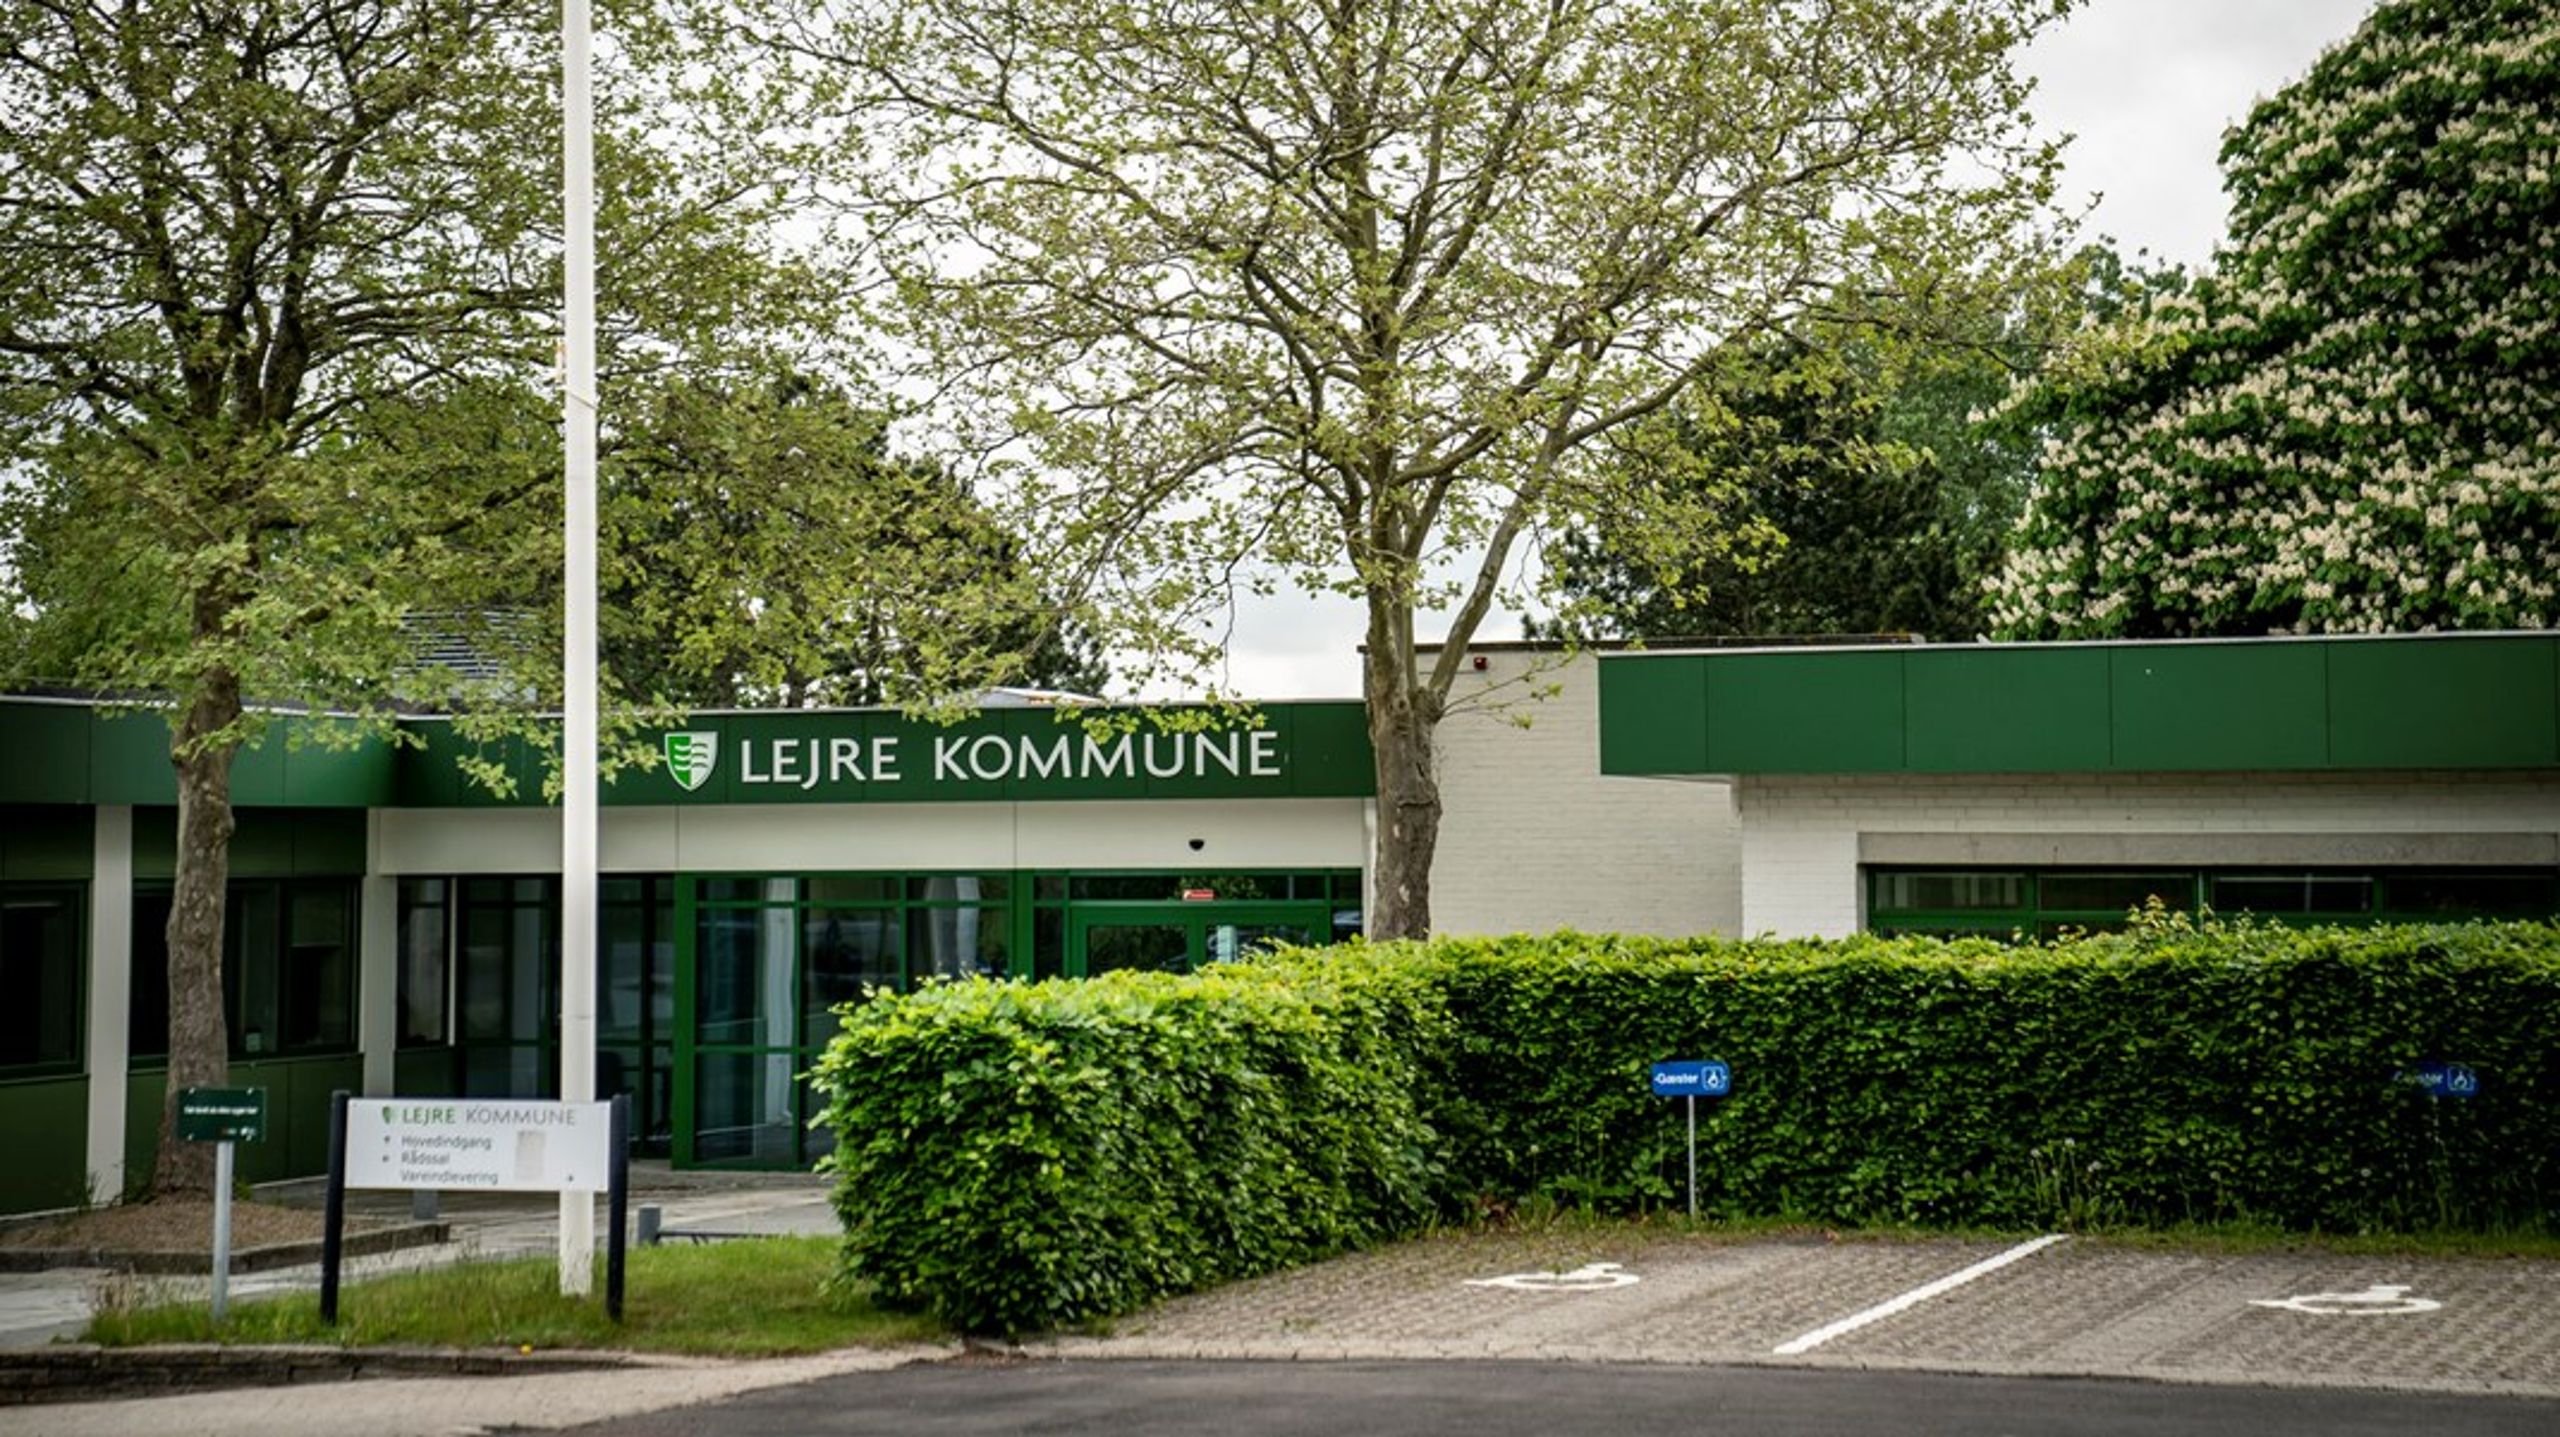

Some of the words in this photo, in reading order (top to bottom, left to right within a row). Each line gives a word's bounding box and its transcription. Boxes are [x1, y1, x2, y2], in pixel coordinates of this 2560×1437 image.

[740, 736, 901, 790] LEJRE
[934, 729, 1281, 782] KOMMUNE
[402, 1106, 456, 1126] LEJRE
[465, 1107, 576, 1126] KOMMUNE
[401, 1134, 492, 1151] Hovedindgang
[401, 1150, 450, 1165] Rådssal
[400, 1169, 499, 1185] Vareindlevering
